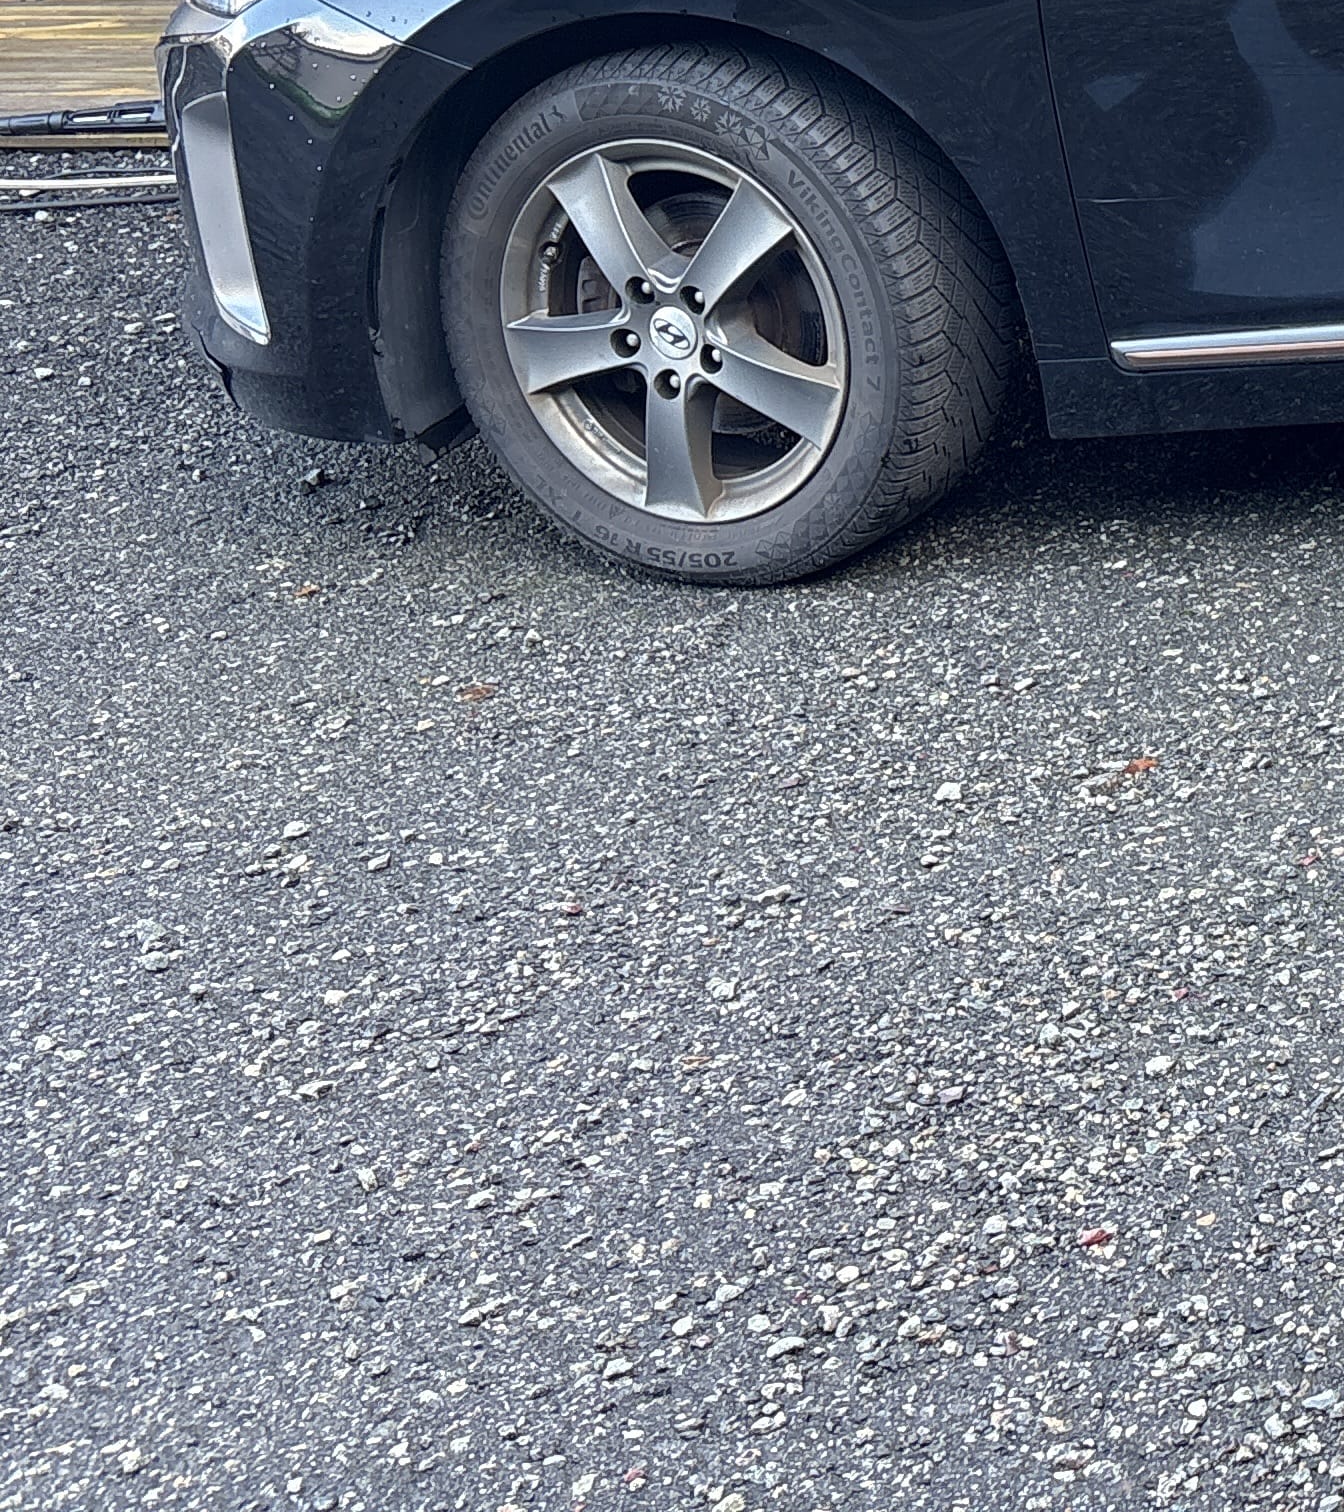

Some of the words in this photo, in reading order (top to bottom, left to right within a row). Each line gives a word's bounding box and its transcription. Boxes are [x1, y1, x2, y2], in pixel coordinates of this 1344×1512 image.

[466, 111, 553, 220] Continental
[787, 169, 881, 365] VikingContact
[866, 375, 882, 392] 7
[624, 537, 643, 557] R
[647, 546, 738, 569] 205/55
